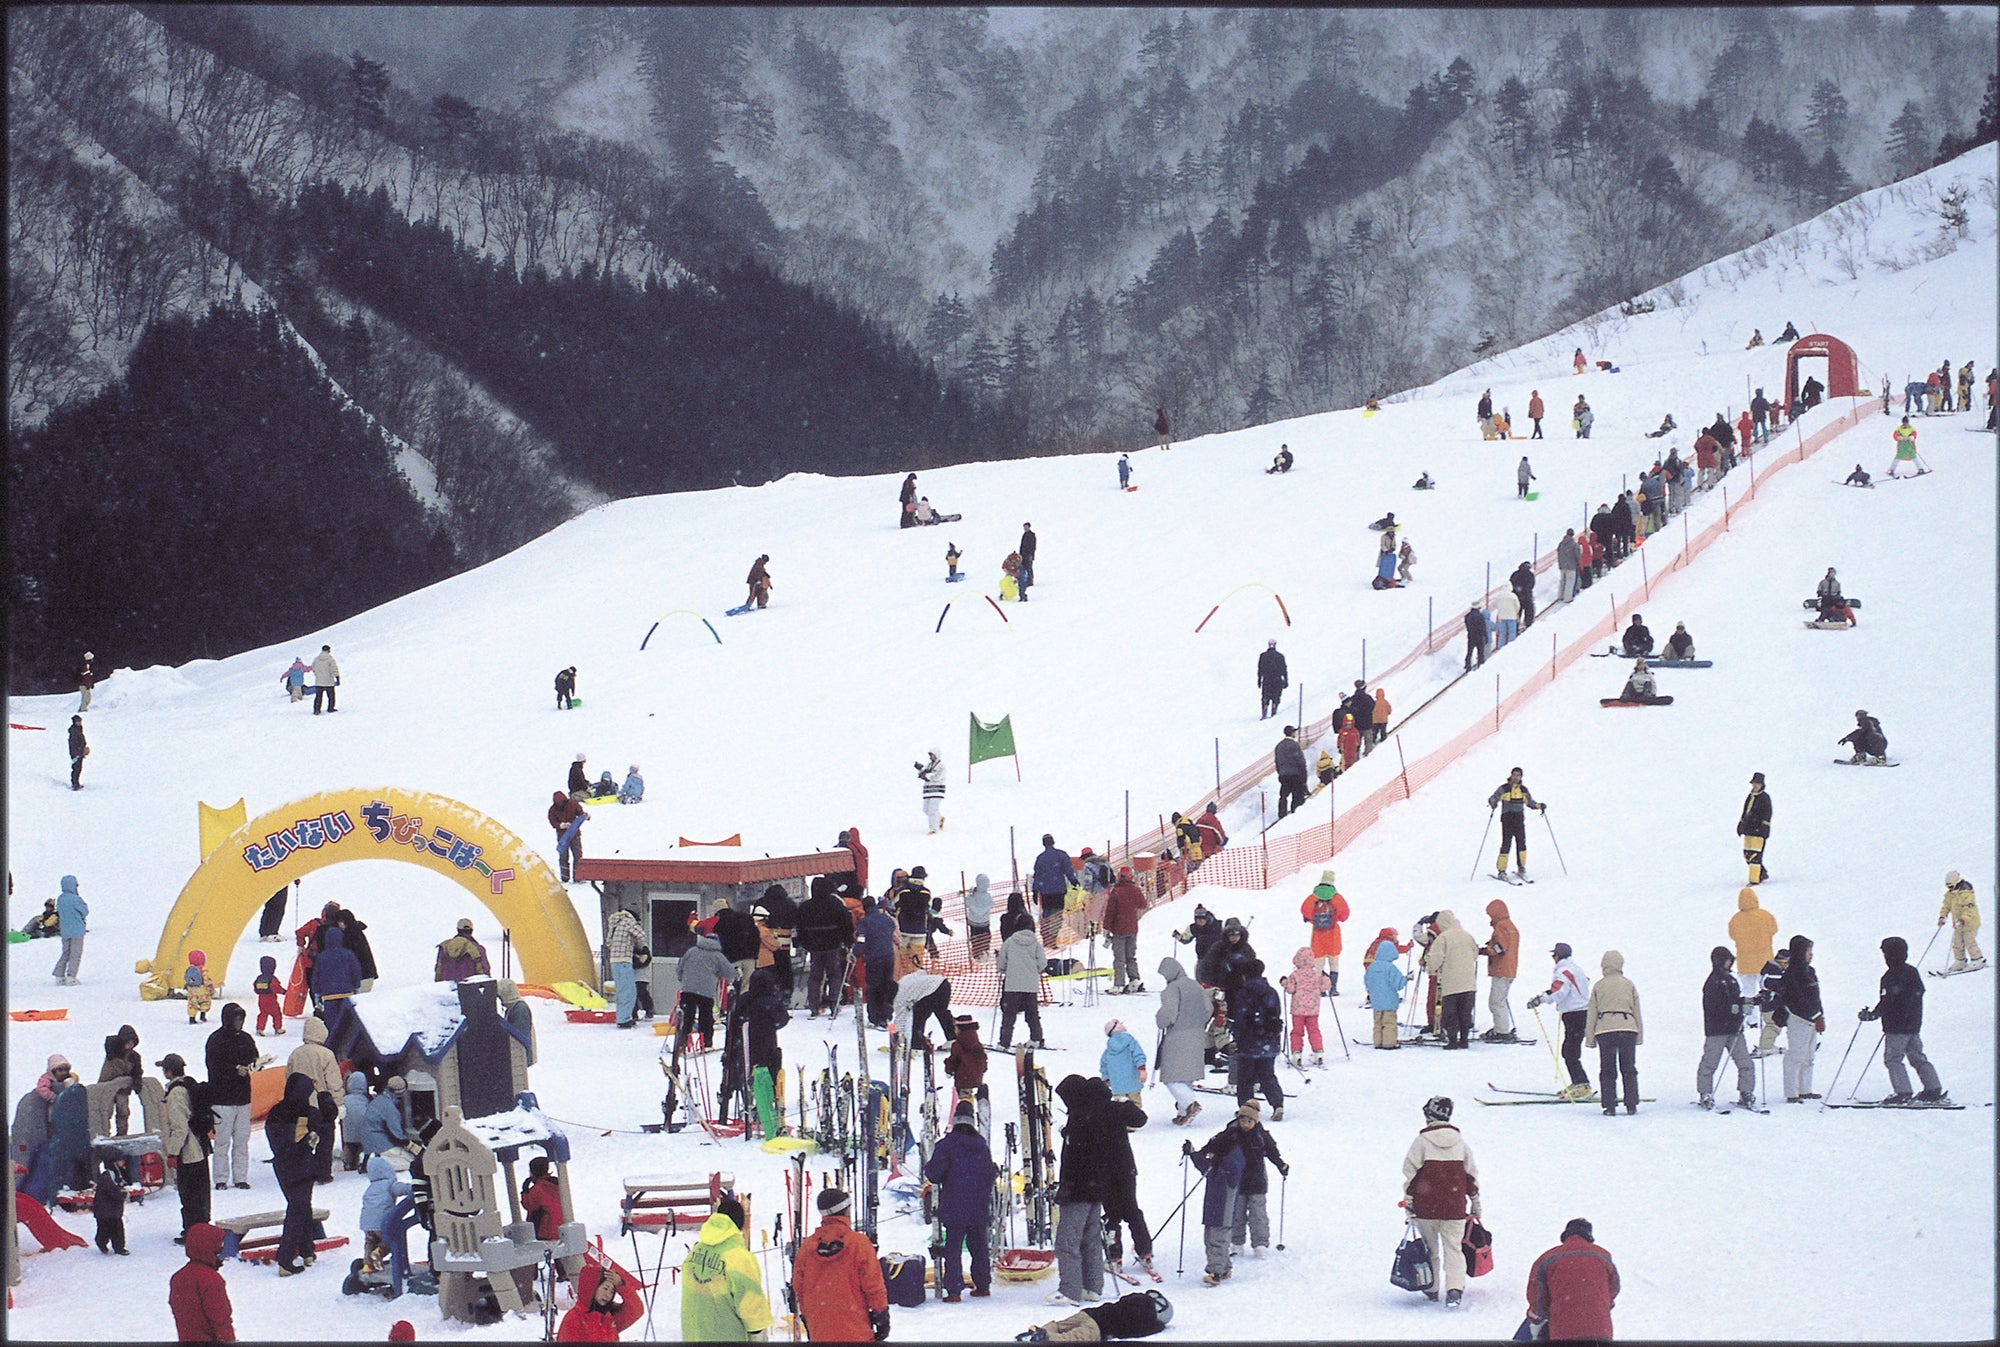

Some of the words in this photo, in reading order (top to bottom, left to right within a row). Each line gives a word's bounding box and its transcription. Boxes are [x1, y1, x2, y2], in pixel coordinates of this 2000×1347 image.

[243, 811, 355, 872] たいない
[361, 800, 515, 894] ちびっこぱーく
